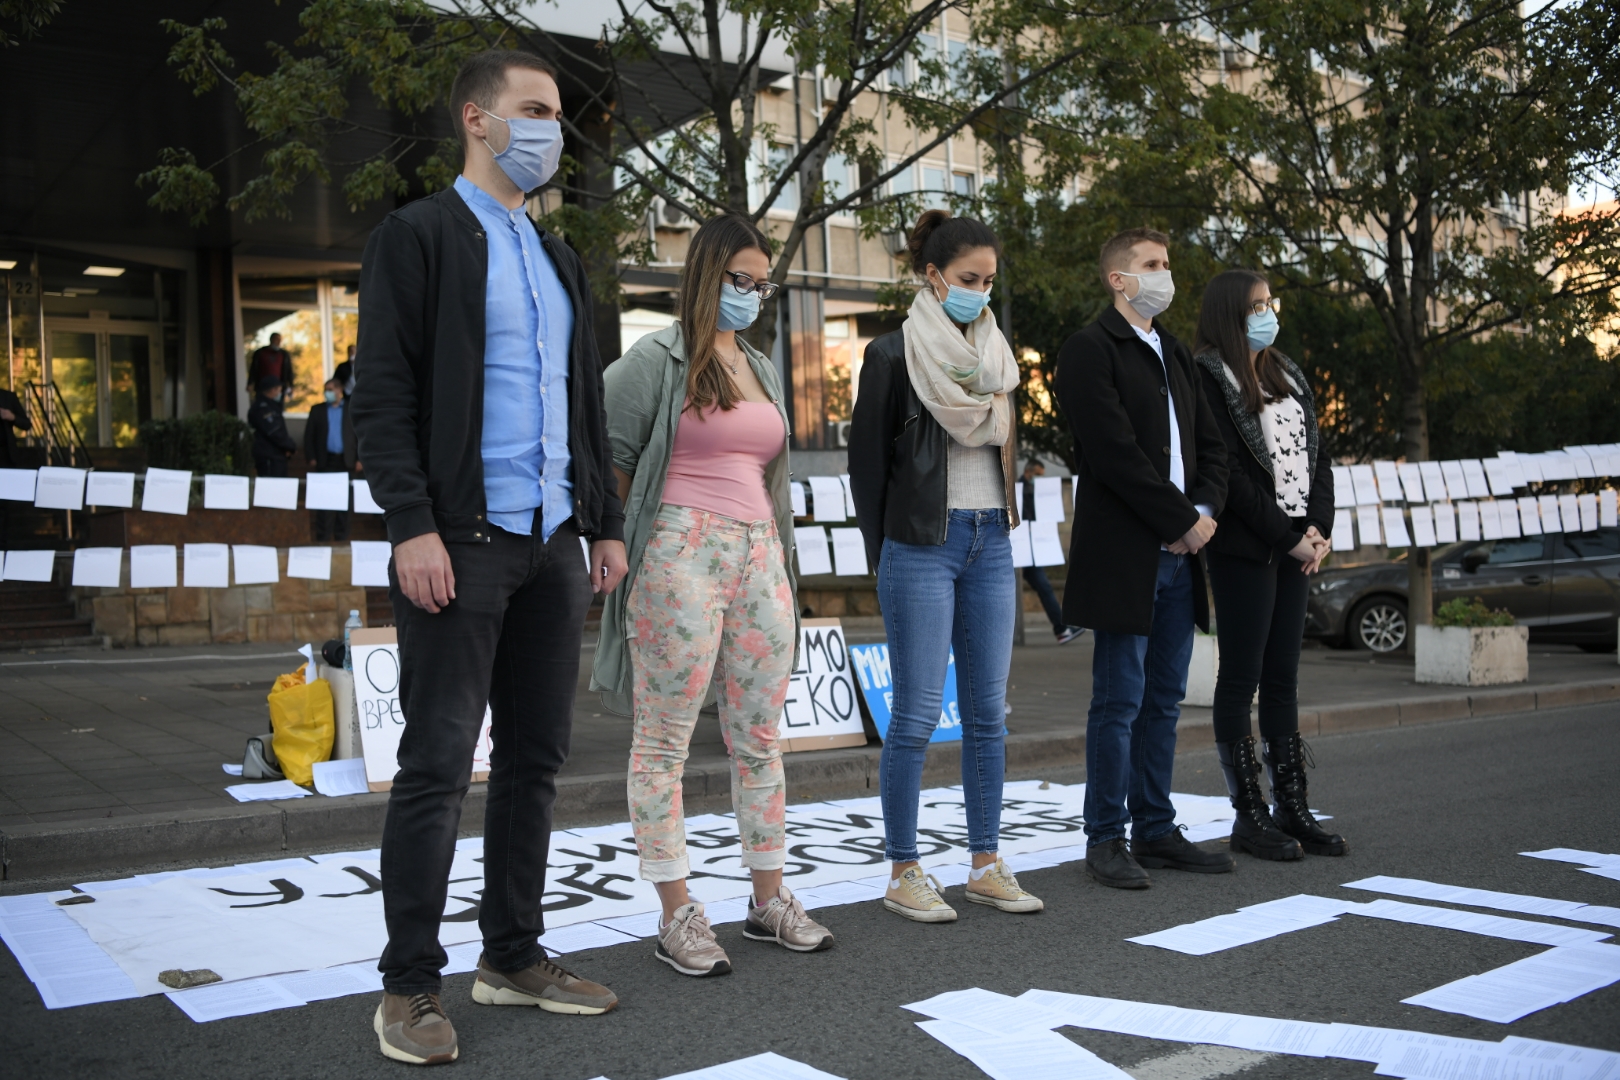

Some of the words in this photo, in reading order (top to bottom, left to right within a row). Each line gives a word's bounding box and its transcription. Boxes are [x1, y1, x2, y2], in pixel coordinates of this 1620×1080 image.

[15, 281, 33, 295] 22
[791, 629, 846, 675] МО
[362, 697, 406, 731] ВРЕ
[784, 675, 853, 728] ЕКО
